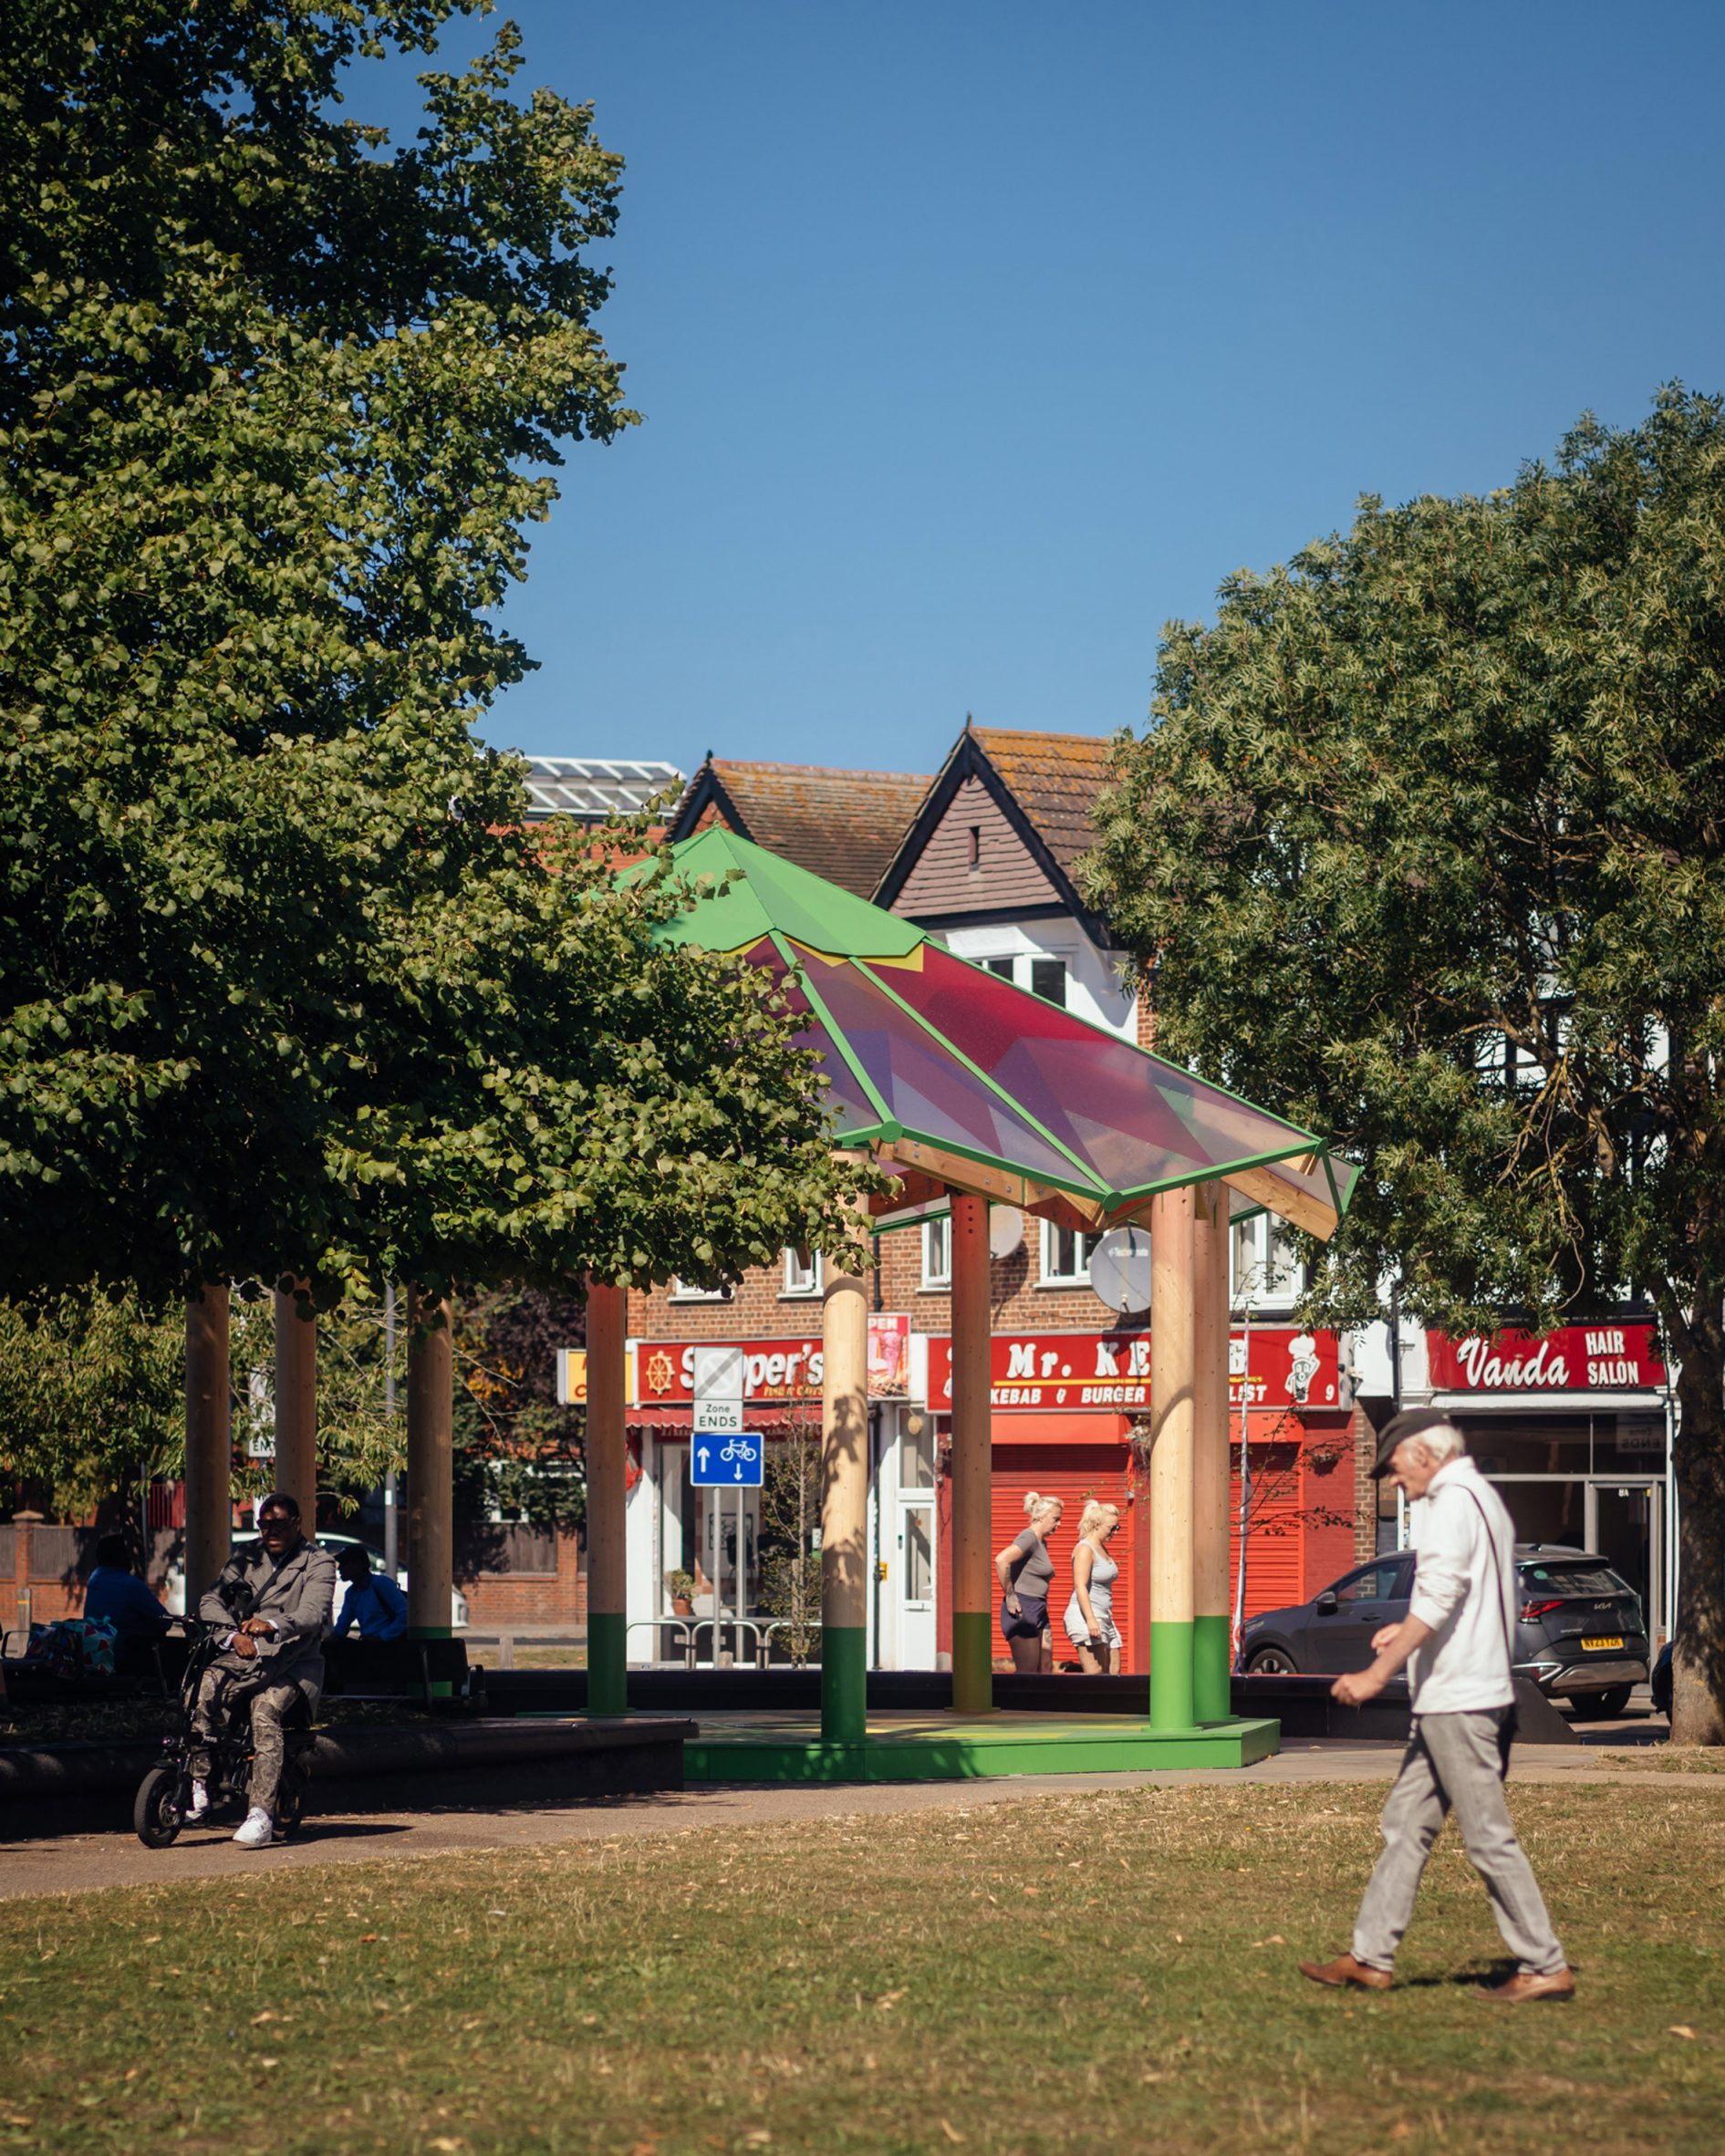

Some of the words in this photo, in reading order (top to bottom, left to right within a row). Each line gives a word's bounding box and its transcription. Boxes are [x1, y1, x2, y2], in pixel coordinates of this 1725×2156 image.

[868, 1318, 898, 1331] PEN
[1585, 1331, 1626, 1356] HAIR
[1006, 1343, 1072, 1378] Mr.
[1095, 1339, 1248, 1377] KEB
[1457, 1336, 1570, 1387] Vanda
[680, 1342, 823, 1398] Sper's
[1587, 1361, 1639, 1386] SALON
[991, 1387, 1042, 1405] KEBAB
[1081, 1385, 1146, 1404] BURGER
[1325, 1384, 1335, 1402] 9
[706, 1404, 730, 1414] Zone
[699, 1416, 737, 1427] ENDS
[253, 1440, 275, 1452] END
